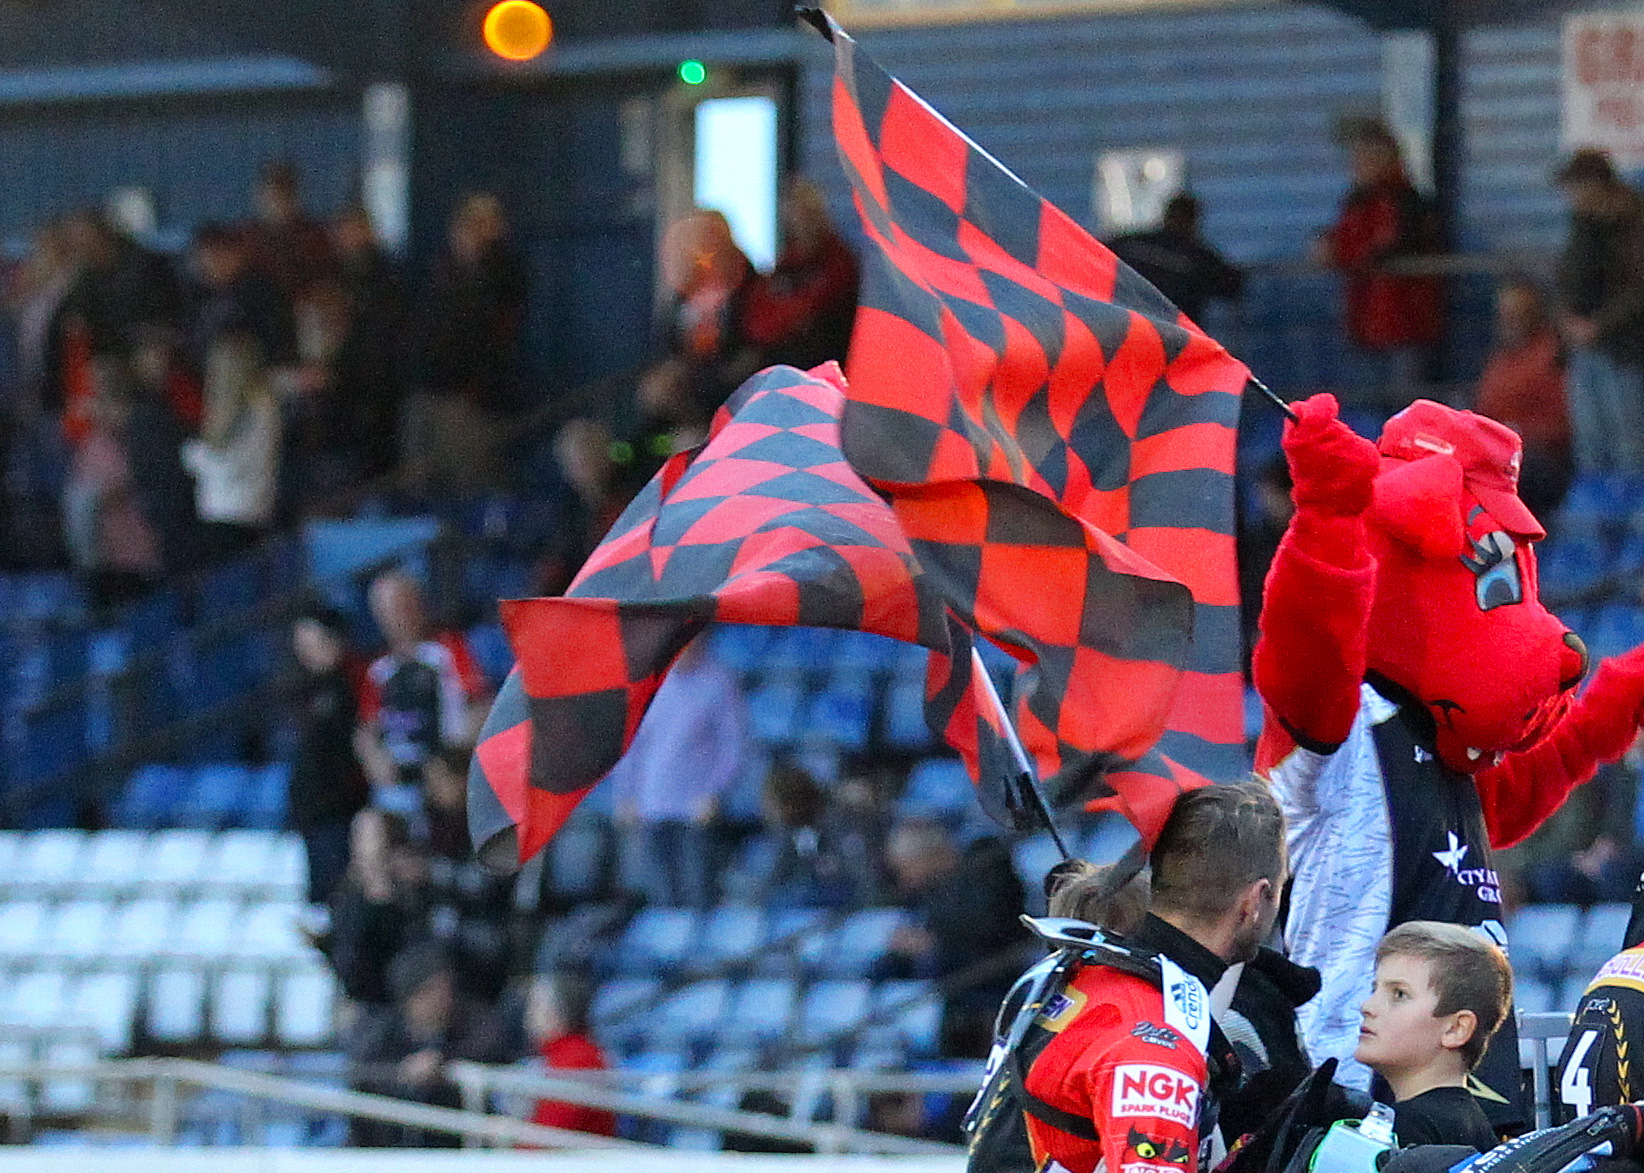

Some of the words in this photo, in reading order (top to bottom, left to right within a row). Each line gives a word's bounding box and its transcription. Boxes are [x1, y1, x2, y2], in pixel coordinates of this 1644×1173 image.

[1122, 1070, 1195, 1110] NGK
[1561, 1030, 1598, 1120] 4
[1121, 1104, 1156, 1113] SPARK
